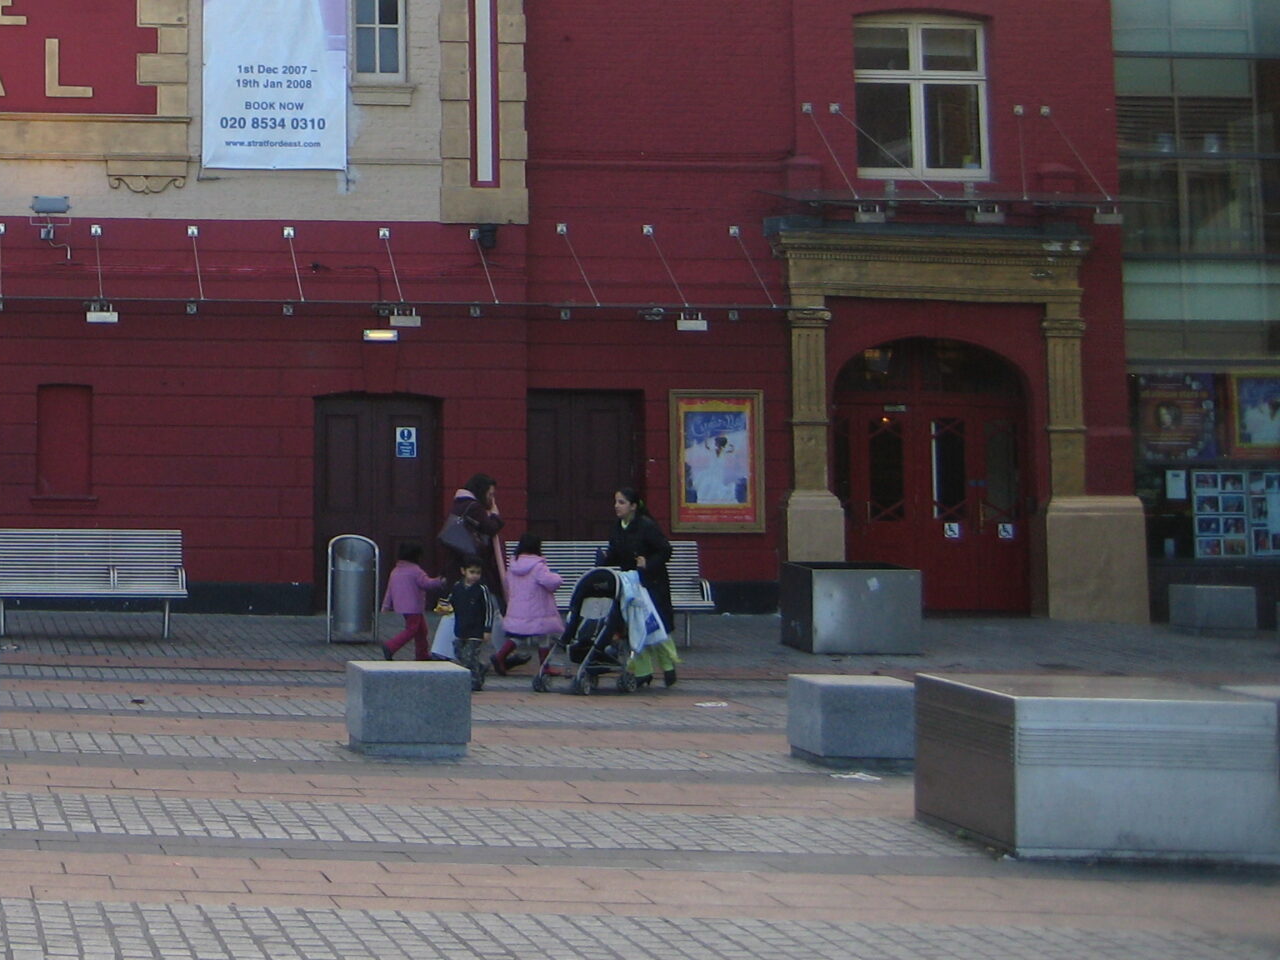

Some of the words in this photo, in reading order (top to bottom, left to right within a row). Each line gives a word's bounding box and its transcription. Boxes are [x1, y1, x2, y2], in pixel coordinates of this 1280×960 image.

[237, 65, 254, 74] 1st
[258, 65, 279, 74] Dec
[282, 65, 308, 75] 2007
[236, 79, 259, 88] 19th
[263, 79, 283, 89] Jan
[286, 79, 312, 89] 2008
[245, 101, 276, 110] BOOK
[279, 102, 305, 111] NOW
[220, 117, 246, 129] 020
[251, 117, 286, 130] 8534
[291, 118, 326, 130] 0310
[225, 140, 321, 148] www.stratfordeast.com
